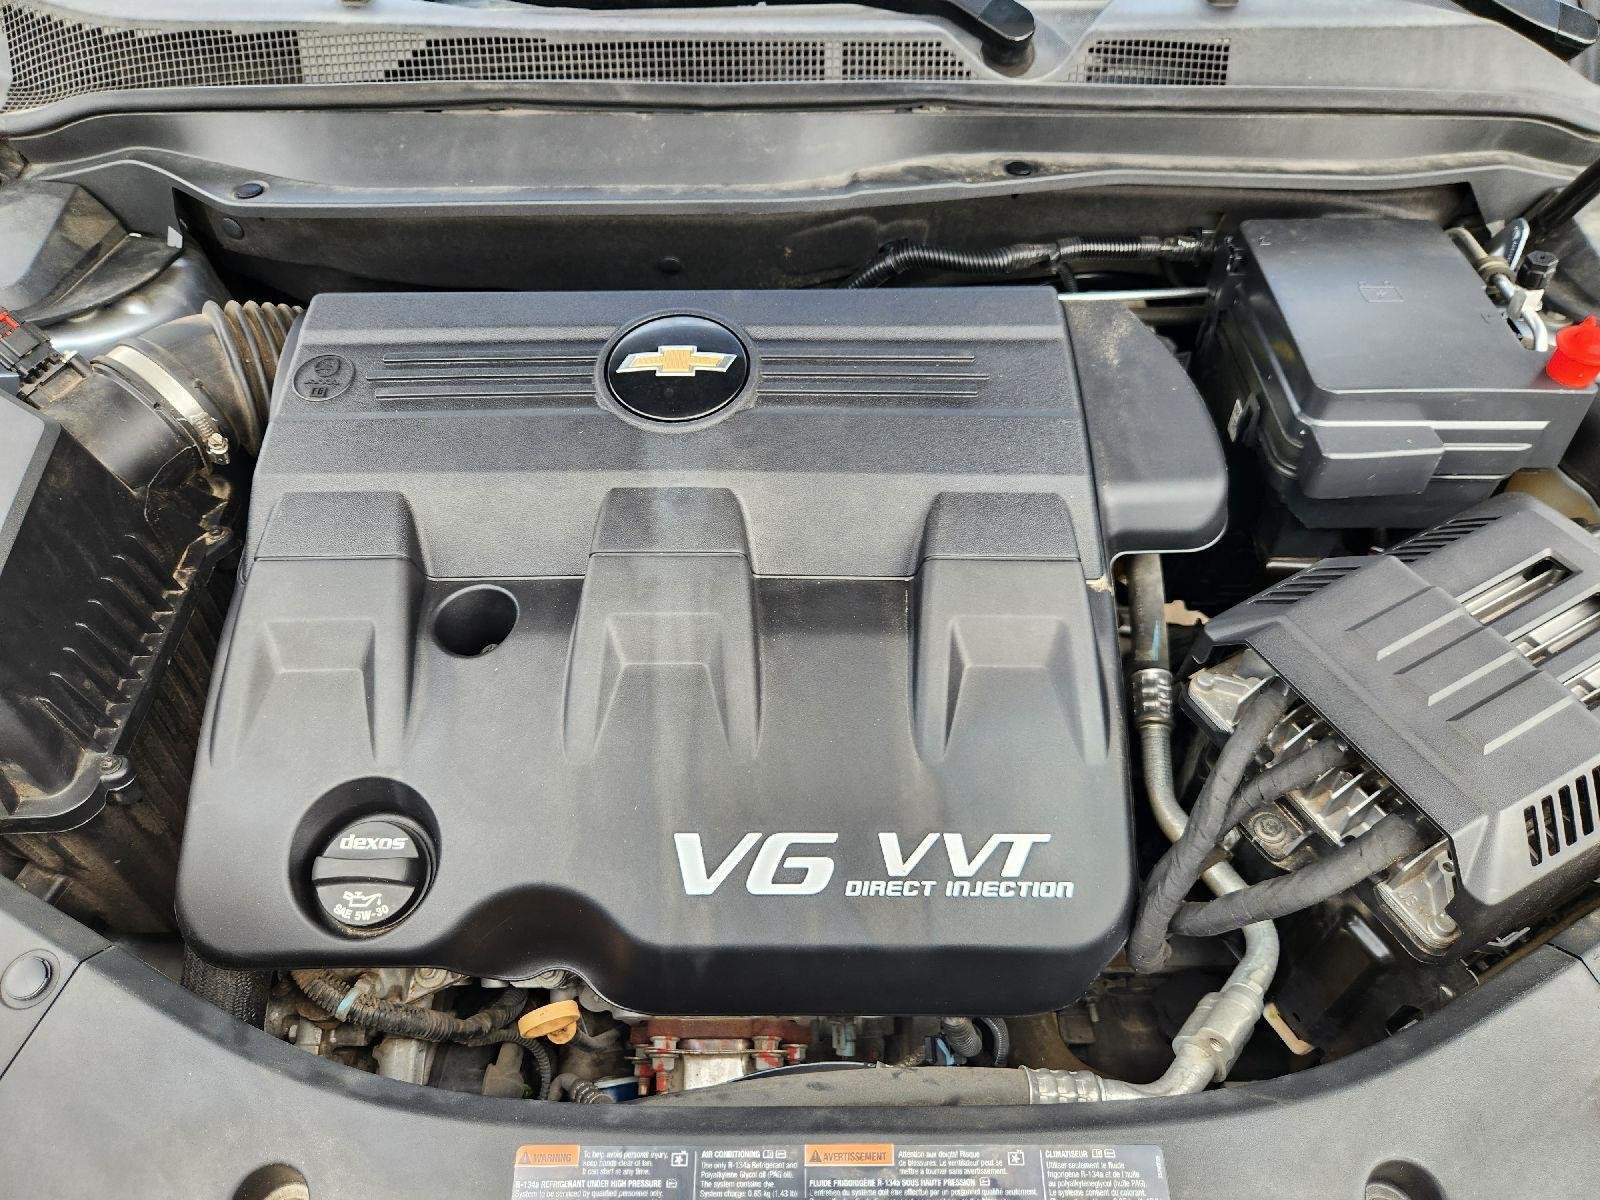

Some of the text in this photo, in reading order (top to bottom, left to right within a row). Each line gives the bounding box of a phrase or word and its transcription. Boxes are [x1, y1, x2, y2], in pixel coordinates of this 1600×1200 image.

[340, 834, 408, 850] dexos
[673, 832, 1052, 895] V6 VVT
[844, 880, 1074, 898] DIRECT INJECTION
[333, 903, 389, 920] SAE 5W-30
[534, 1153, 572, 1162] WARNING
[592, 1151, 605, 1160] help
[623, 1151, 650, 1160] personal
[702, 1150, 761, 1158] AIR CONDITIONING
[823, 1151, 886, 1161] AVERTISSEMENT
[960, 1151, 980, 1160] Risque
[714, 1162, 726, 1170] only
[752, 1162, 785, 1170] Refrigerant
[1046, 1161, 1067, 1169] Utiliser
[1068, 1161, 1100, 1169] seulement
[1108, 1161, 1125, 1169] fluide
[623, 1168, 634, 1176] any
[701, 1171, 738, 1180] Polyalkylene
[739, 1171, 758, 1180] Glycol
[1081, 1170, 1104, 1178] R-134a
[515, 1180, 662, 1188] R-134a REFRIGERANT UNDER HIGH PRESSURE
[713, 1181, 735, 1189] system
[515, 1190, 537, 1198] System
[591, 1190, 617, 1198] qualified
[618, 1190, 649, 1198] personnel
[700, 1190, 723, 1198] System
[951, 1189, 980, 1198] personnel
